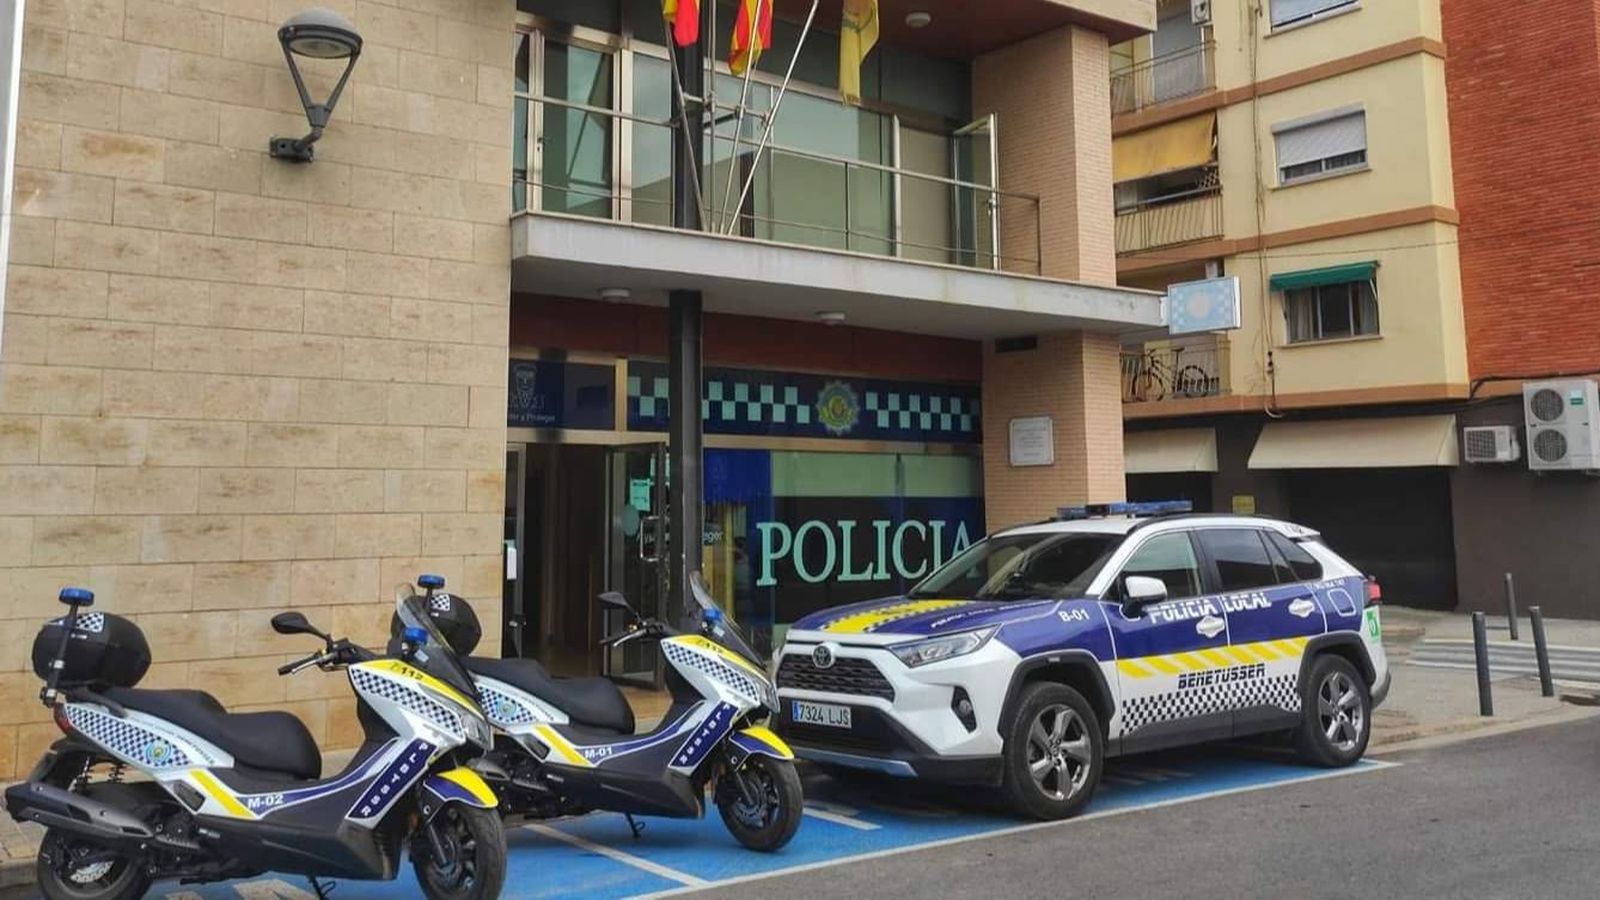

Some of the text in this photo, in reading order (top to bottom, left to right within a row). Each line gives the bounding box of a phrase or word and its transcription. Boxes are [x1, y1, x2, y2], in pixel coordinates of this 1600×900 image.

[756, 519, 982, 586] POLICIA
[1058, 608, 1090, 622] B-01
[1142, 592, 1272, 624] POLICIA LOCAL
[401, 666, 424, 681] 112
[800, 704, 849, 726] 7324 LJS
[584, 746, 612, 759] M-01
[247, 793, 284, 809] M-02
